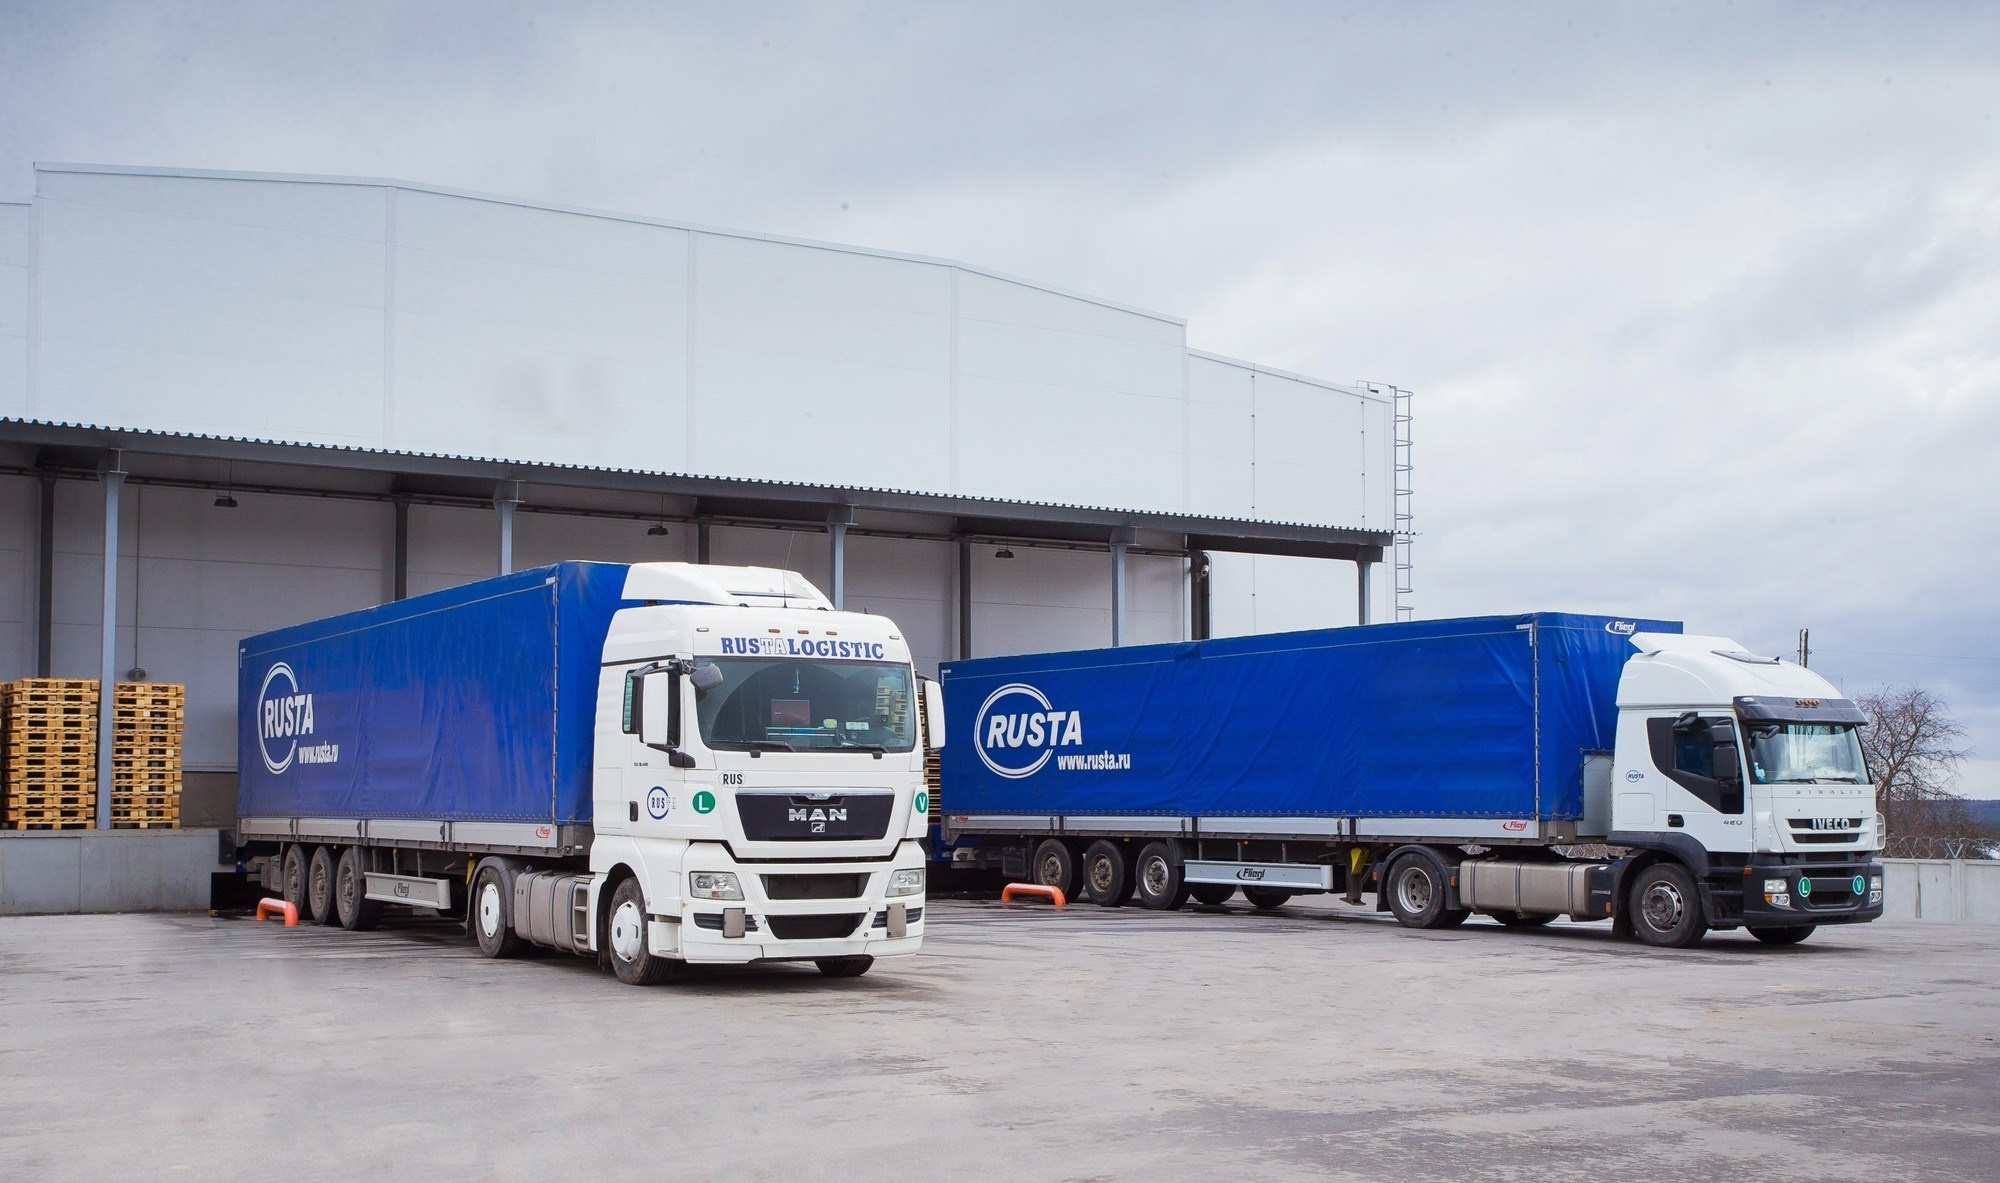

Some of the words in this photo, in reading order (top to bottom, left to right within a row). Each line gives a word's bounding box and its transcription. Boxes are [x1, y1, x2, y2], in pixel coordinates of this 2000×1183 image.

[721, 637, 884, 660] RUSTALOGISTIC
[264, 693, 314, 739] RUSTA
[986, 710, 1083, 749] RUSTA
[298, 740, 339, 764] www.rusta.ru
[1057, 750, 1131, 771] www.rusta.ru
[723, 773, 743, 785] RUS
[698, 794, 710, 811] L
[918, 796, 927, 811] V
[788, 808, 848, 822] MAN
[1812, 818, 1850, 830] IVECO
[1802, 880, 1809, 893] L
[1855, 877, 1863, 891] V
